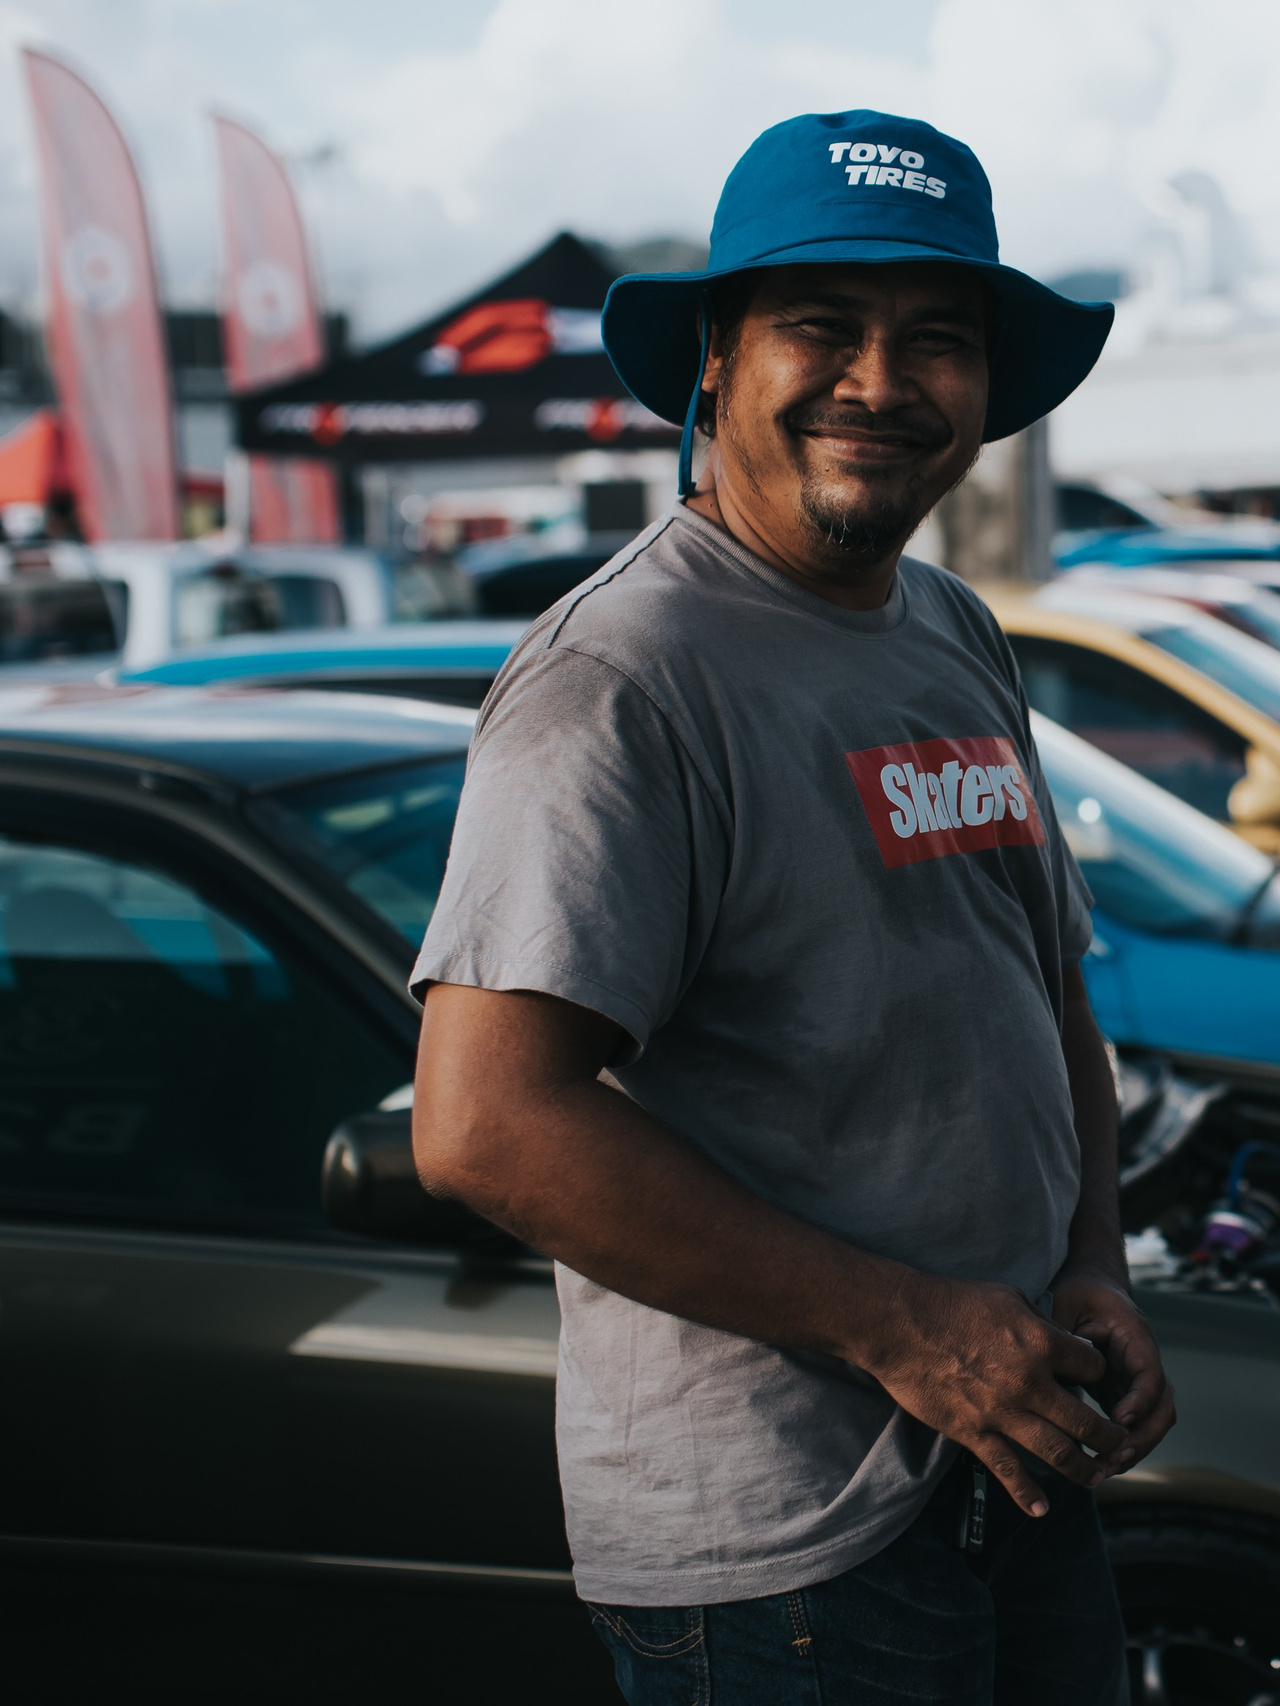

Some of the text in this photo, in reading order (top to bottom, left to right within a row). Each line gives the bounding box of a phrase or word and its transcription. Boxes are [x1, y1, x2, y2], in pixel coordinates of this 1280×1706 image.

[828, 142, 925, 169] TOYO
[844, 165, 947, 199] TIRES
[880, 760, 1028, 838] Skaters
